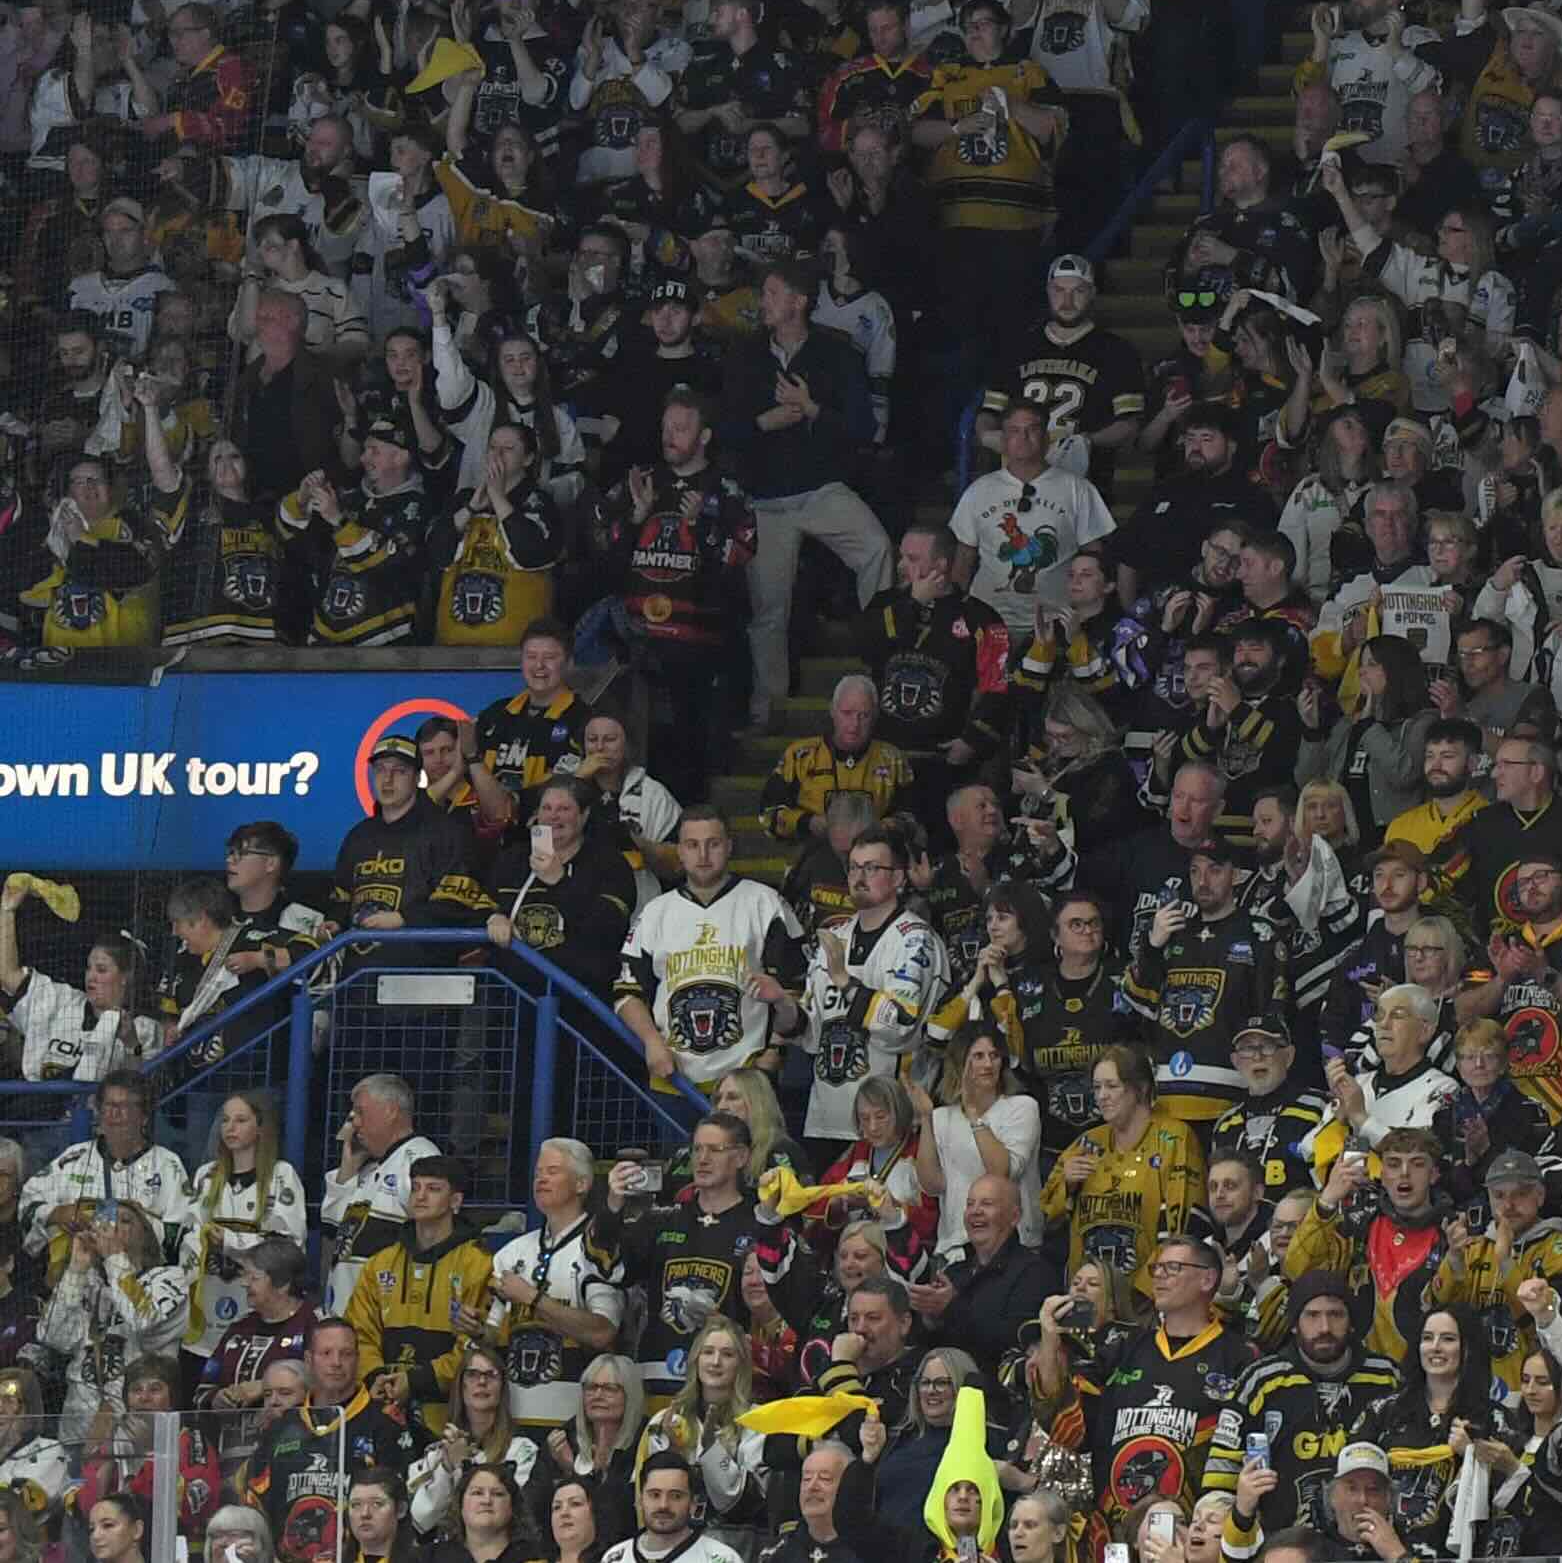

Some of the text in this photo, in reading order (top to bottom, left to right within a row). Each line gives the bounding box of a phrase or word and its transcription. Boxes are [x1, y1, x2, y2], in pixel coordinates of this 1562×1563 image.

[0, 750, 319, 797] own UK tour?
[824, 984, 850, 1011] GM
[668, 1263, 726, 1287] PANTHERS
[1114, 1406, 1198, 1436] NOTTINGHAM
[1292, 1428, 1346, 1461] GM
